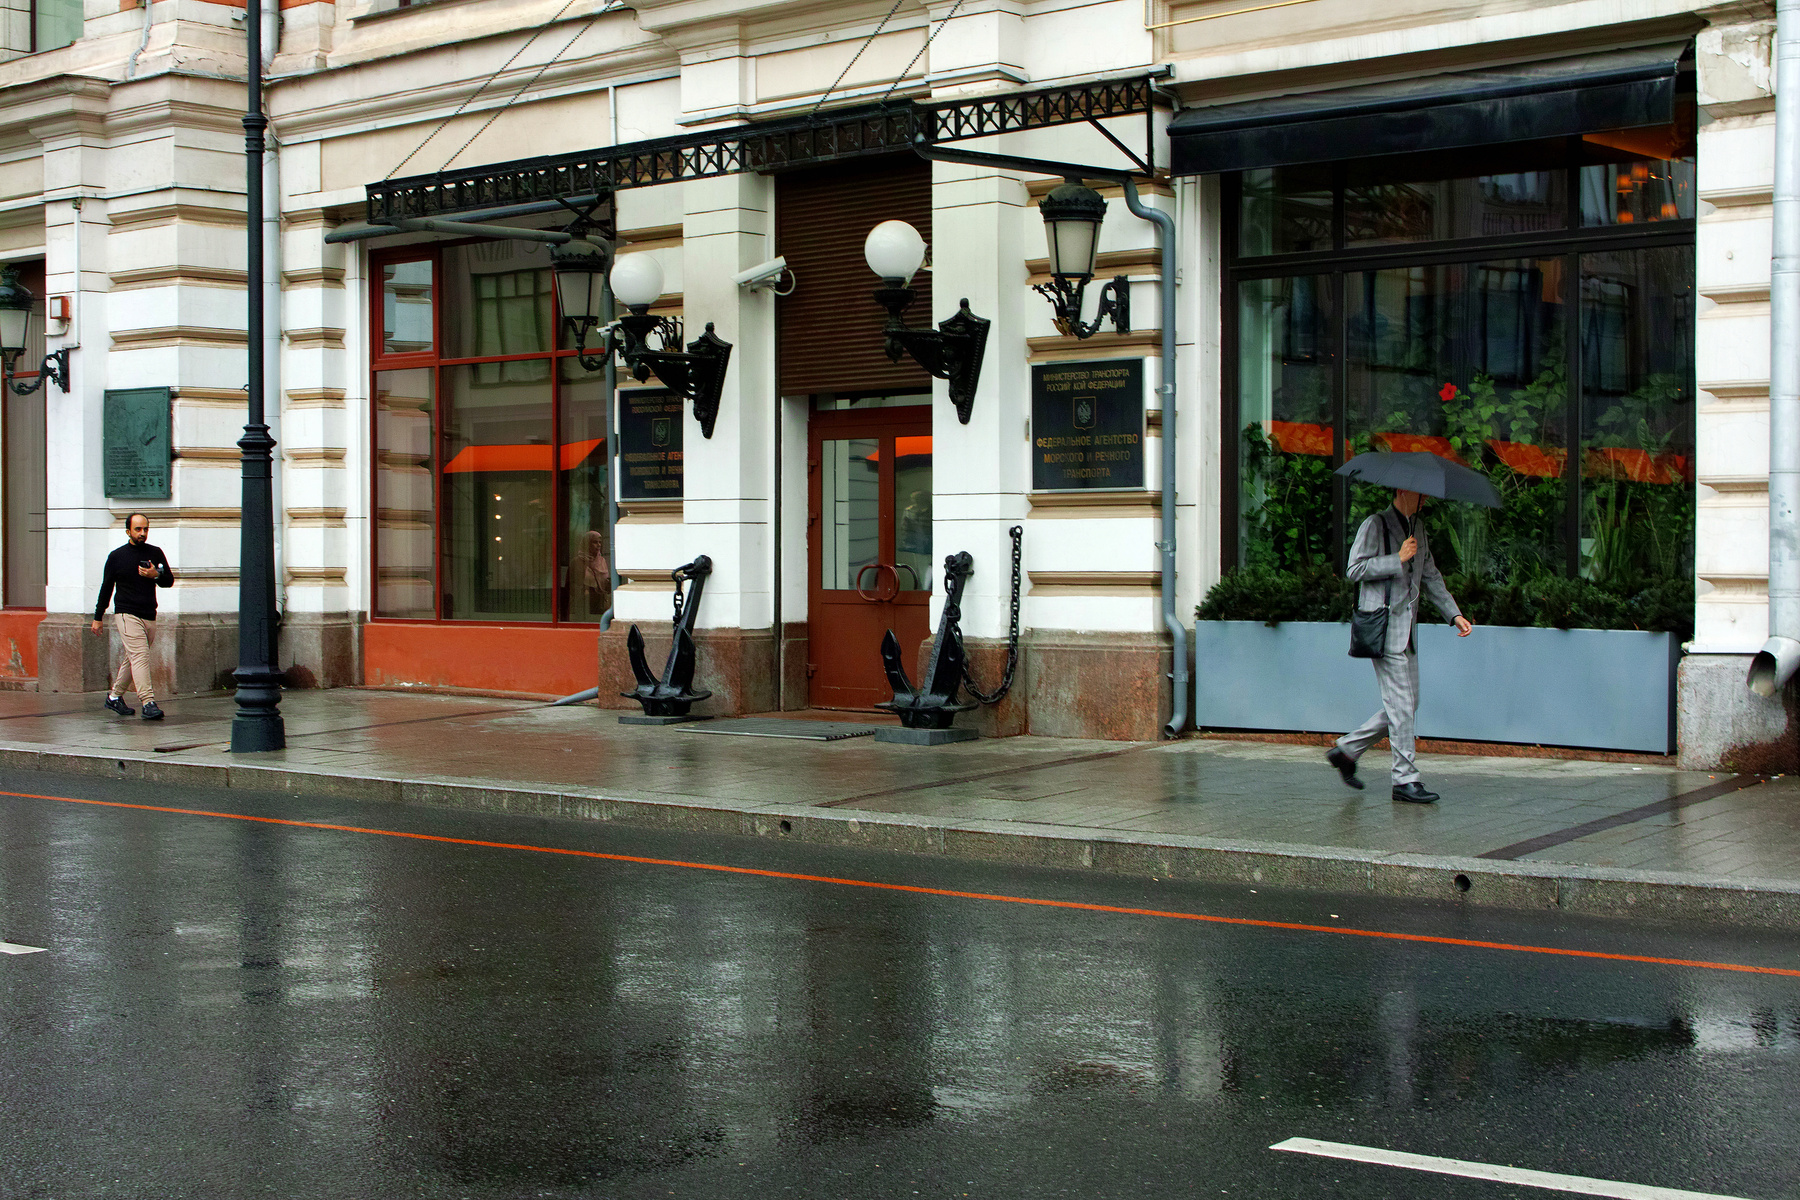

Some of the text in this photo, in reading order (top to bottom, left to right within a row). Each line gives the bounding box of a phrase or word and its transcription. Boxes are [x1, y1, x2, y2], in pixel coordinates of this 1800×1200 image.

[1043, 368, 1130, 382] МИНИСТЕРСТВО ТРАНСПОРТА
[1087, 379, 1126, 390] ФЕДЕРАЦИИ
[1036, 433, 1139, 450] ФЕДЕРАЛЬНОЕ АГЕНТСТВО
[1043, 450, 1131, 464] МОРСКОГО И РЕЧНОГО
[1062, 467, 1111, 479] ТРАНСПОРТА
